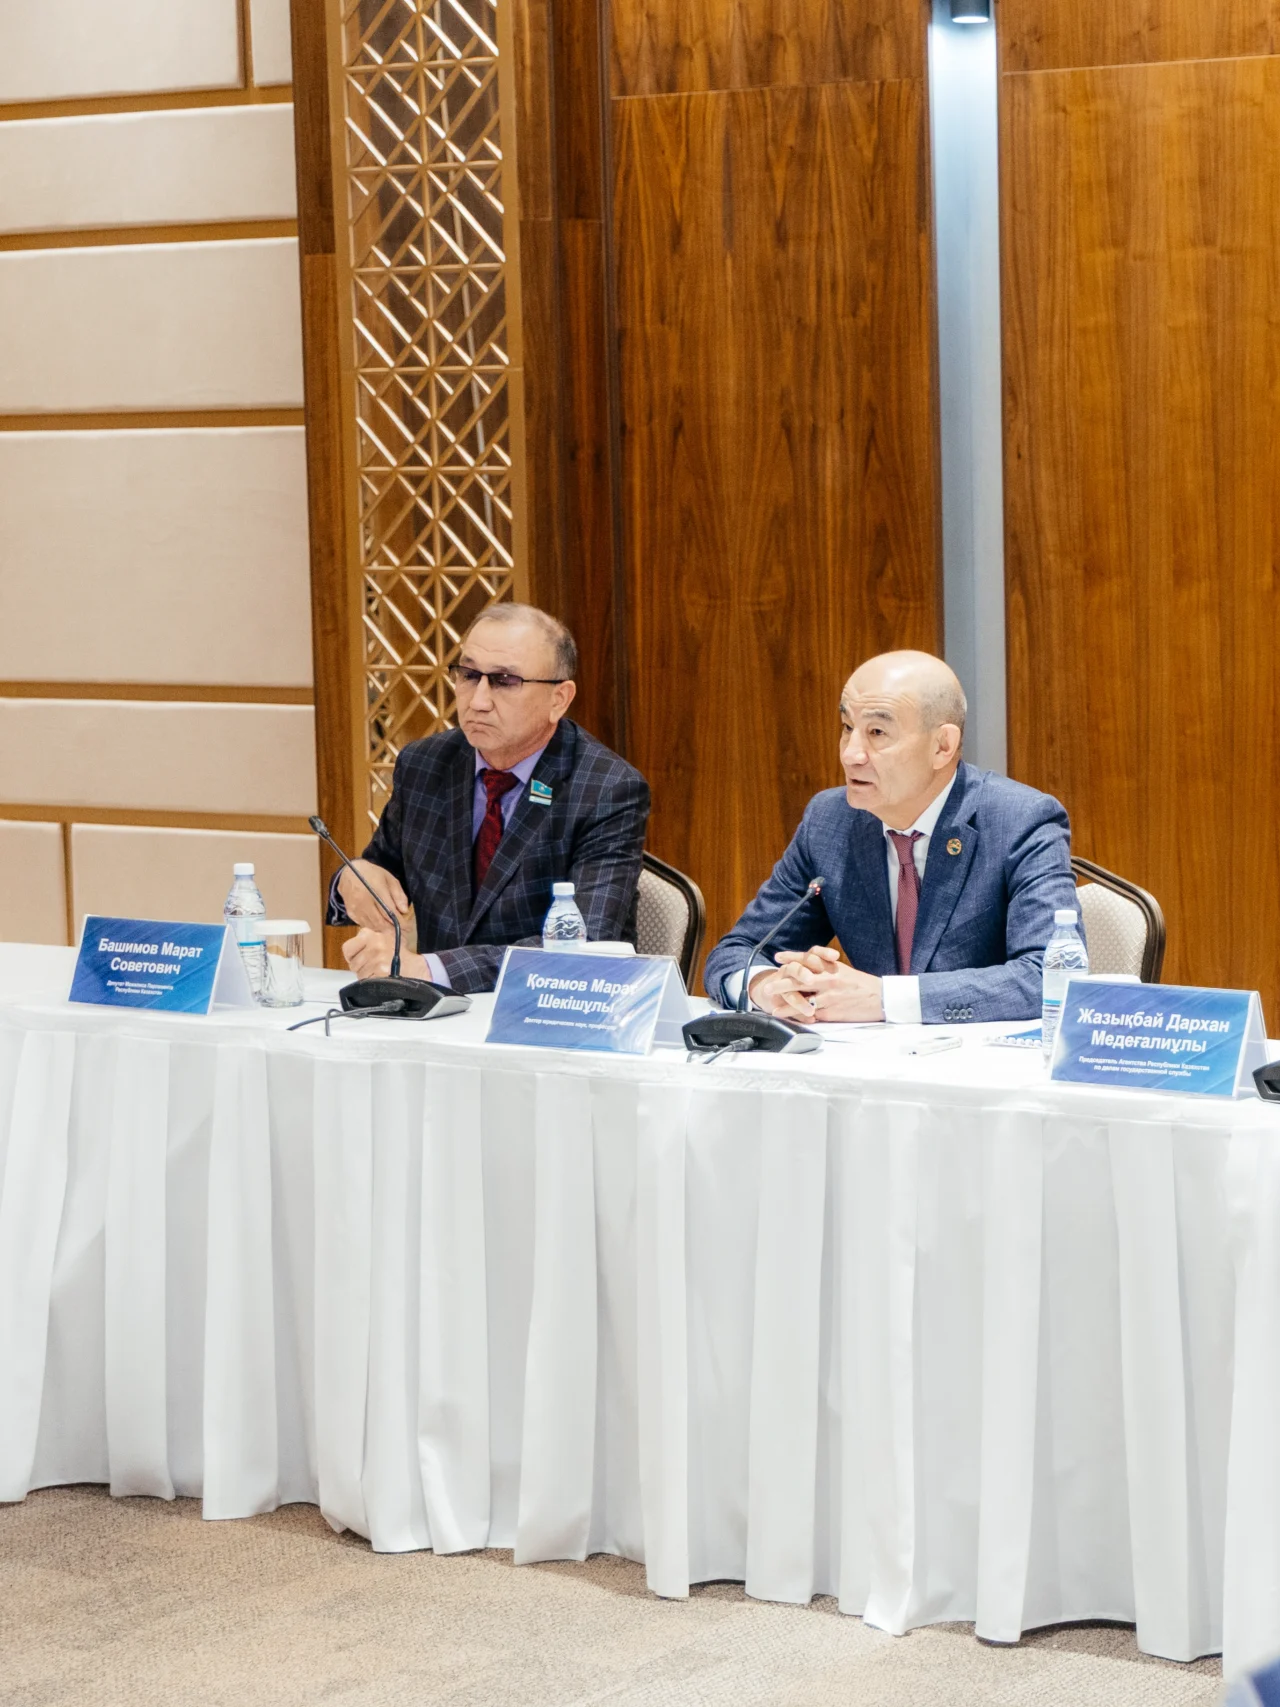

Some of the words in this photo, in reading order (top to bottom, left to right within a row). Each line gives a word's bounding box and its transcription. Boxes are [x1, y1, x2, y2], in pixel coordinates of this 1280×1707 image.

[98, 938, 159, 955] Башимов
[161, 942, 204, 960] Марат
[110, 957, 181, 975] Советович
[526, 973, 588, 990] Қоғамов
[590, 979, 638, 997] Марат
[537, 993, 615, 1014] Шекішұлы
[1077, 1007, 1164, 1030] Жазықбай
[1165, 1013, 1230, 1034] Дархан
[1091, 1030, 1207, 1054] Медеғалиұлы
